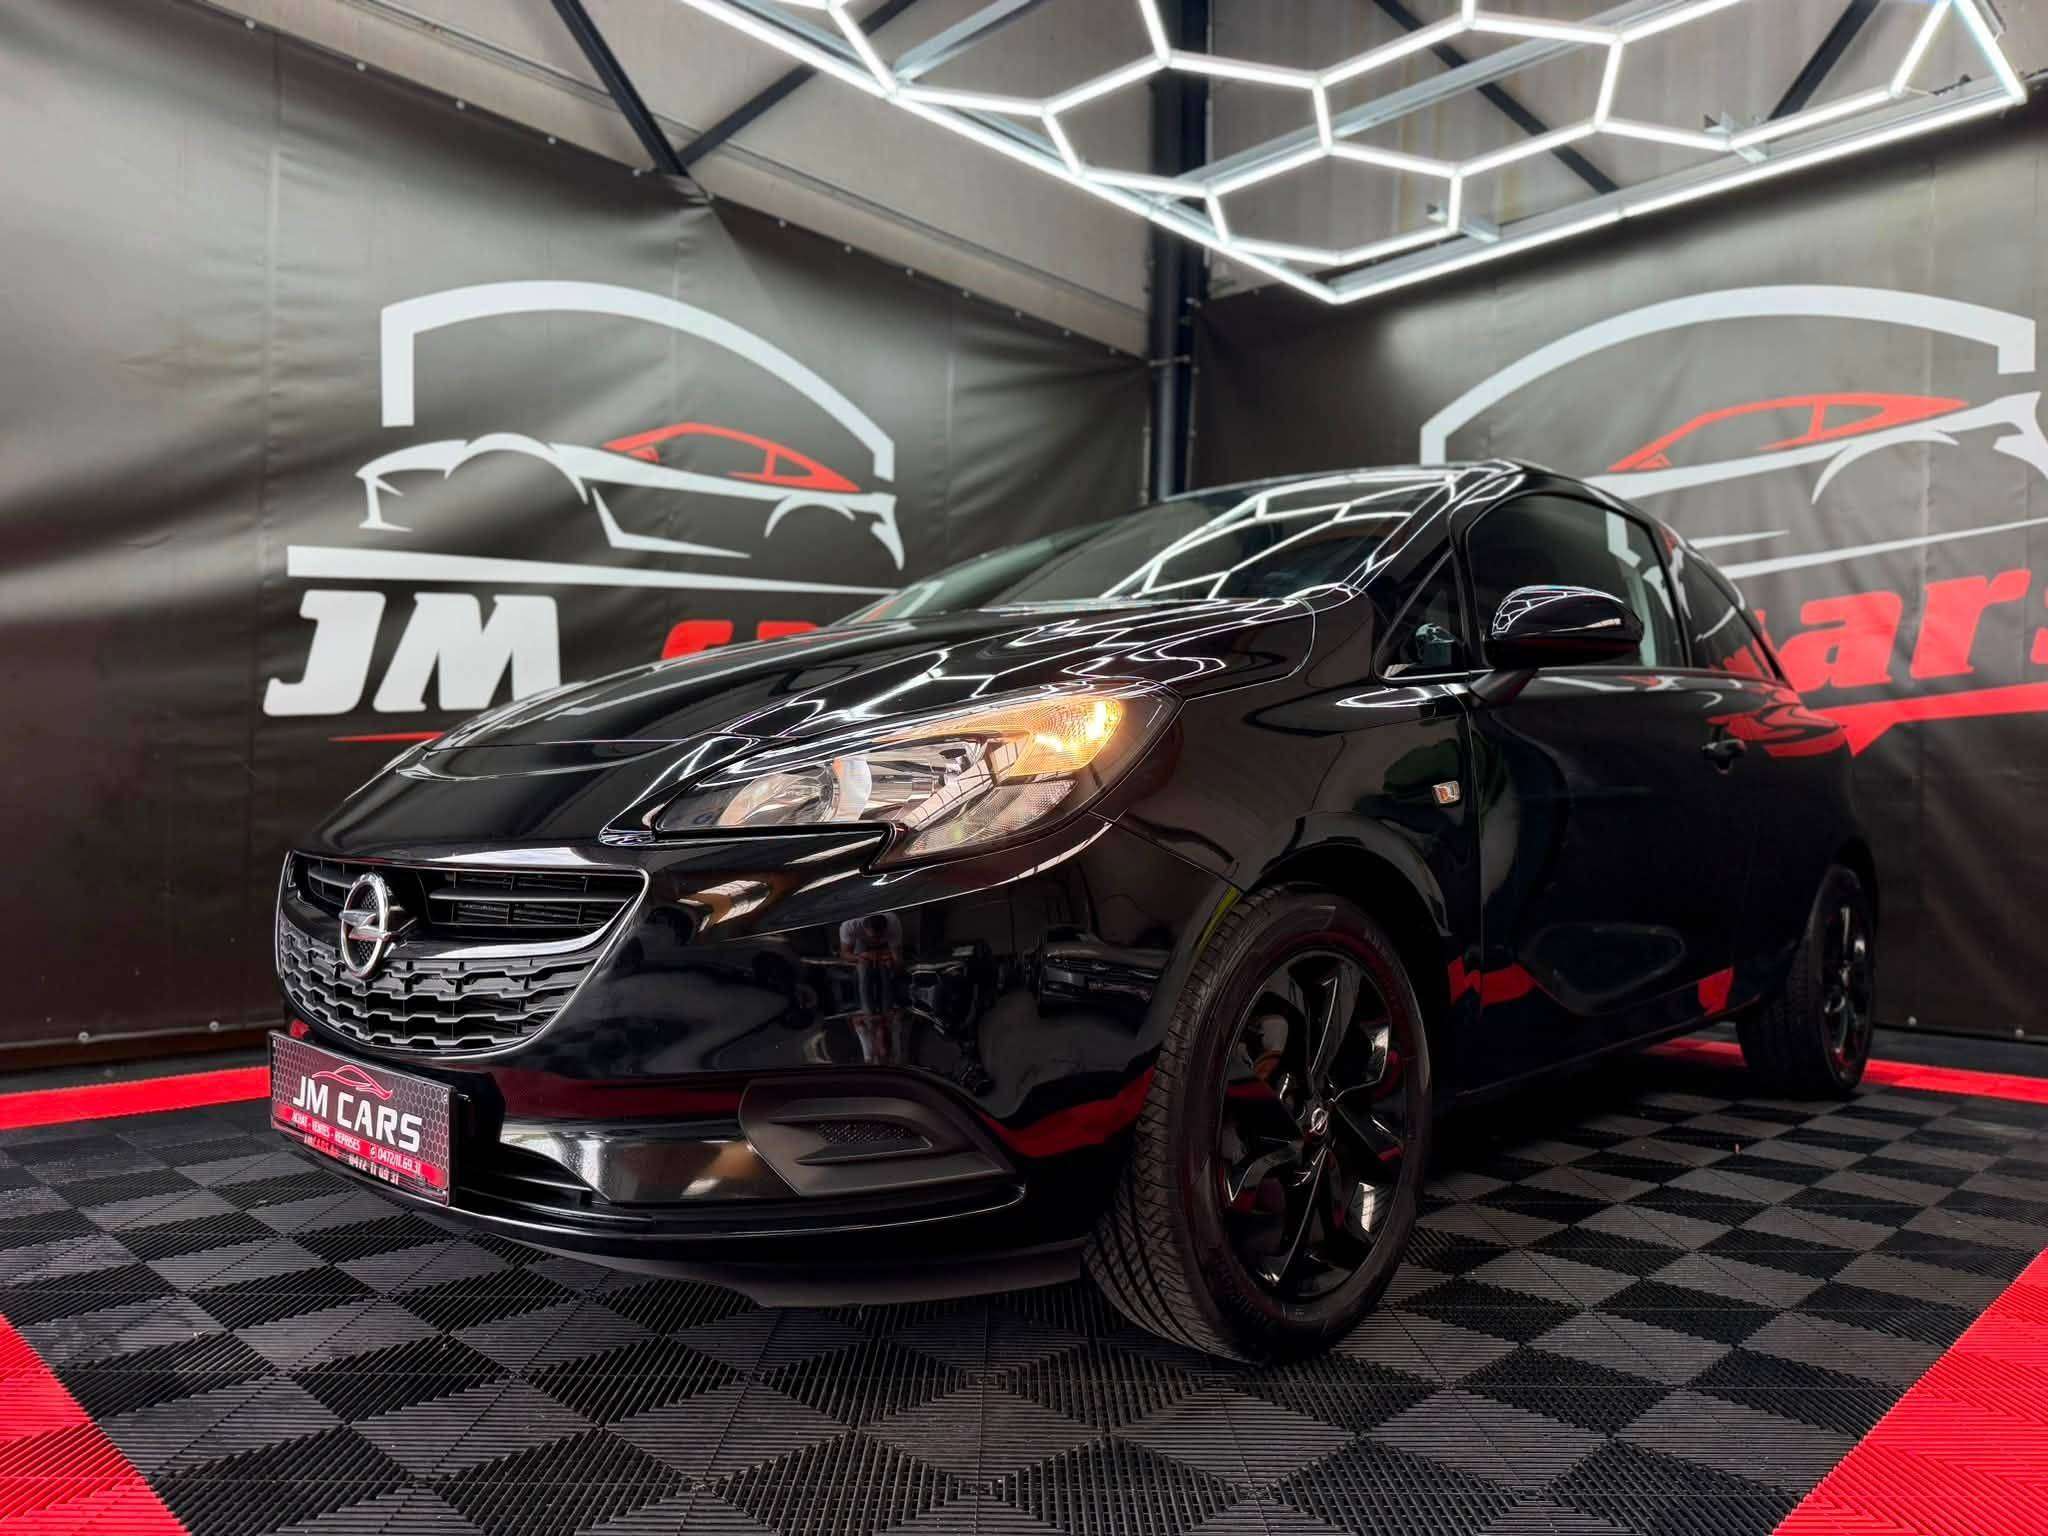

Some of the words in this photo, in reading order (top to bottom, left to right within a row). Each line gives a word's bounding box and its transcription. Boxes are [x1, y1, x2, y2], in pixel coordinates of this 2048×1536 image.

[263, 590, 561, 717] JM
[1754, 568, 2048, 693] ar
[293, 1076, 329, 1118] JM
[337, 1092, 423, 1153] CARS
